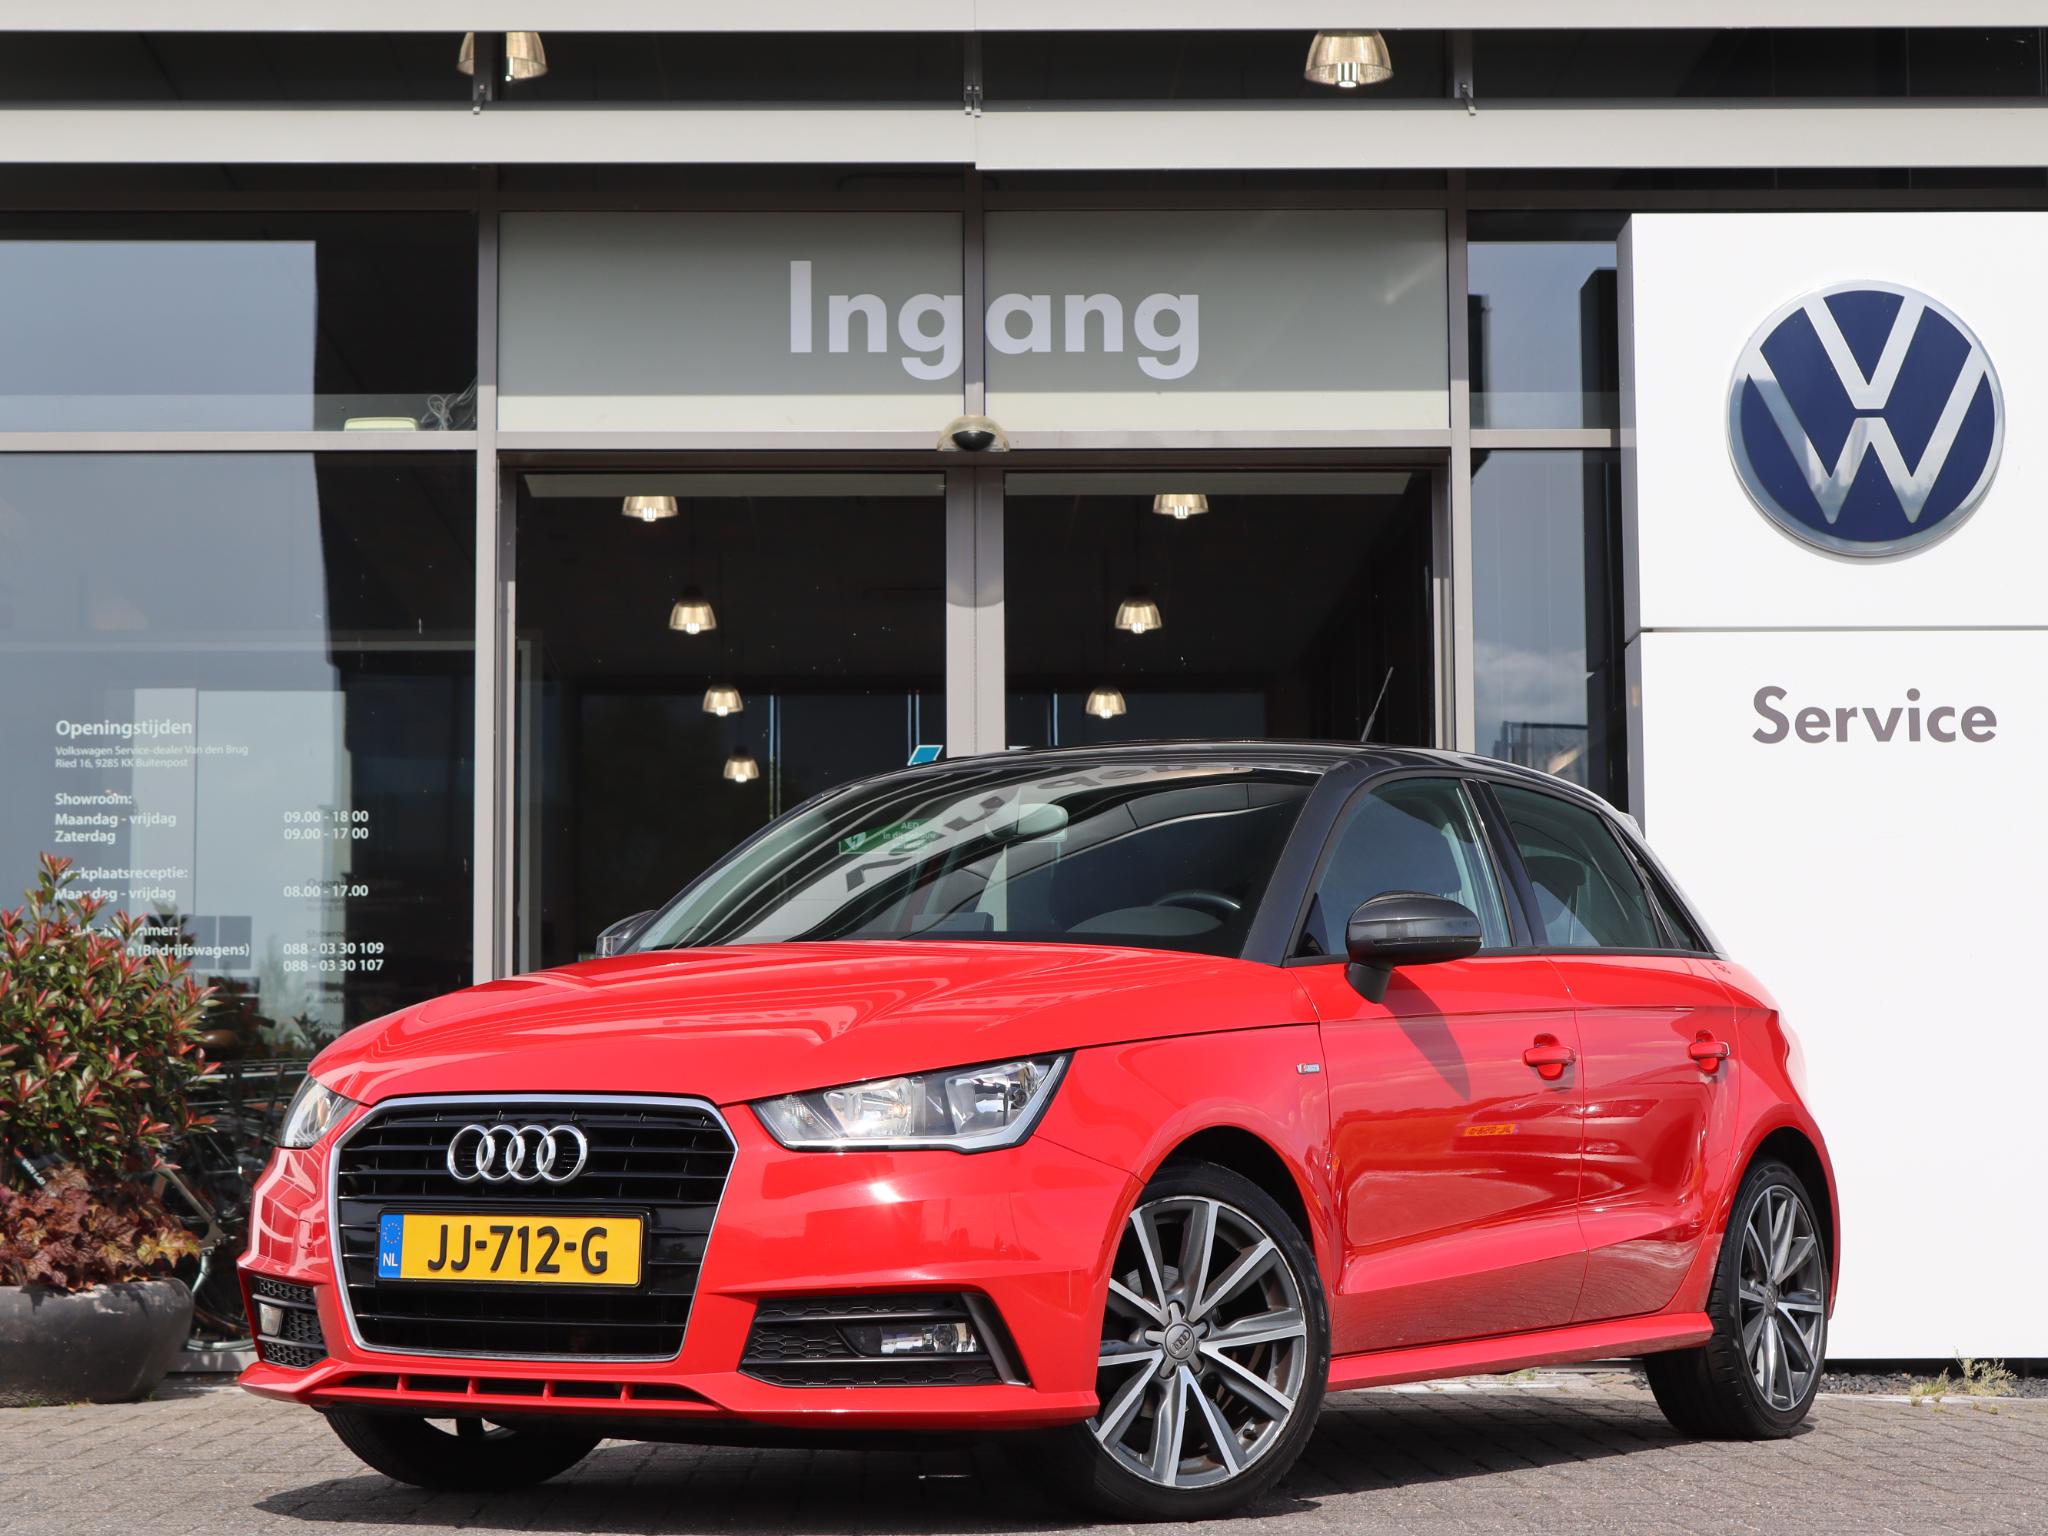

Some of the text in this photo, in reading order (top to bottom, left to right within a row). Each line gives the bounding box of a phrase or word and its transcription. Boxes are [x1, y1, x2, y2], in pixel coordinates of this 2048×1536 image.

[790, 260, 1199, 380] Ingang
[1752, 685, 1998, 745] Service
[55, 719, 193, 739] Openingstijden
[55, 745, 113, 757] Volkswagen
[184, 744, 203, 755] Van
[204, 744, 224, 754] den
[225, 743, 249, 757] Brug
[55, 758, 77, 768] Ried
[95, 758, 119, 768] 9285
[121, 758, 134, 768] KK
[135, 757, 189, 769] Buitenpost
[55, 792, 133, 805] Showroom:
[55, 812, 118, 828] Maandag
[129, 812, 177, 828] vrijdag
[283, 811, 321, 823] 09.00
[332, 810, 369, 823] 1800
[55, 830, 116, 844] Zaterdag
[283, 828, 321, 840] 09.00
[332, 827, 369, 839] 1700
[129, 886, 177, 902] vrijdag
[283, 885, 321, 898] 08.00
[332, 885, 369, 897] 17.00
[283, 943, 309, 955] 088
[319, 943, 336, 955] 03
[339, 942, 357, 954] 30
[359, 942, 385, 954] 109
[283, 960, 309, 972] 088
[319, 960, 336, 972] 03
[339, 959, 357, 971] 30
[359, 959, 385, 971] 107
[427, 1224, 608, 1275] JJ-712-G
[382, 1252, 399, 1268] NL
